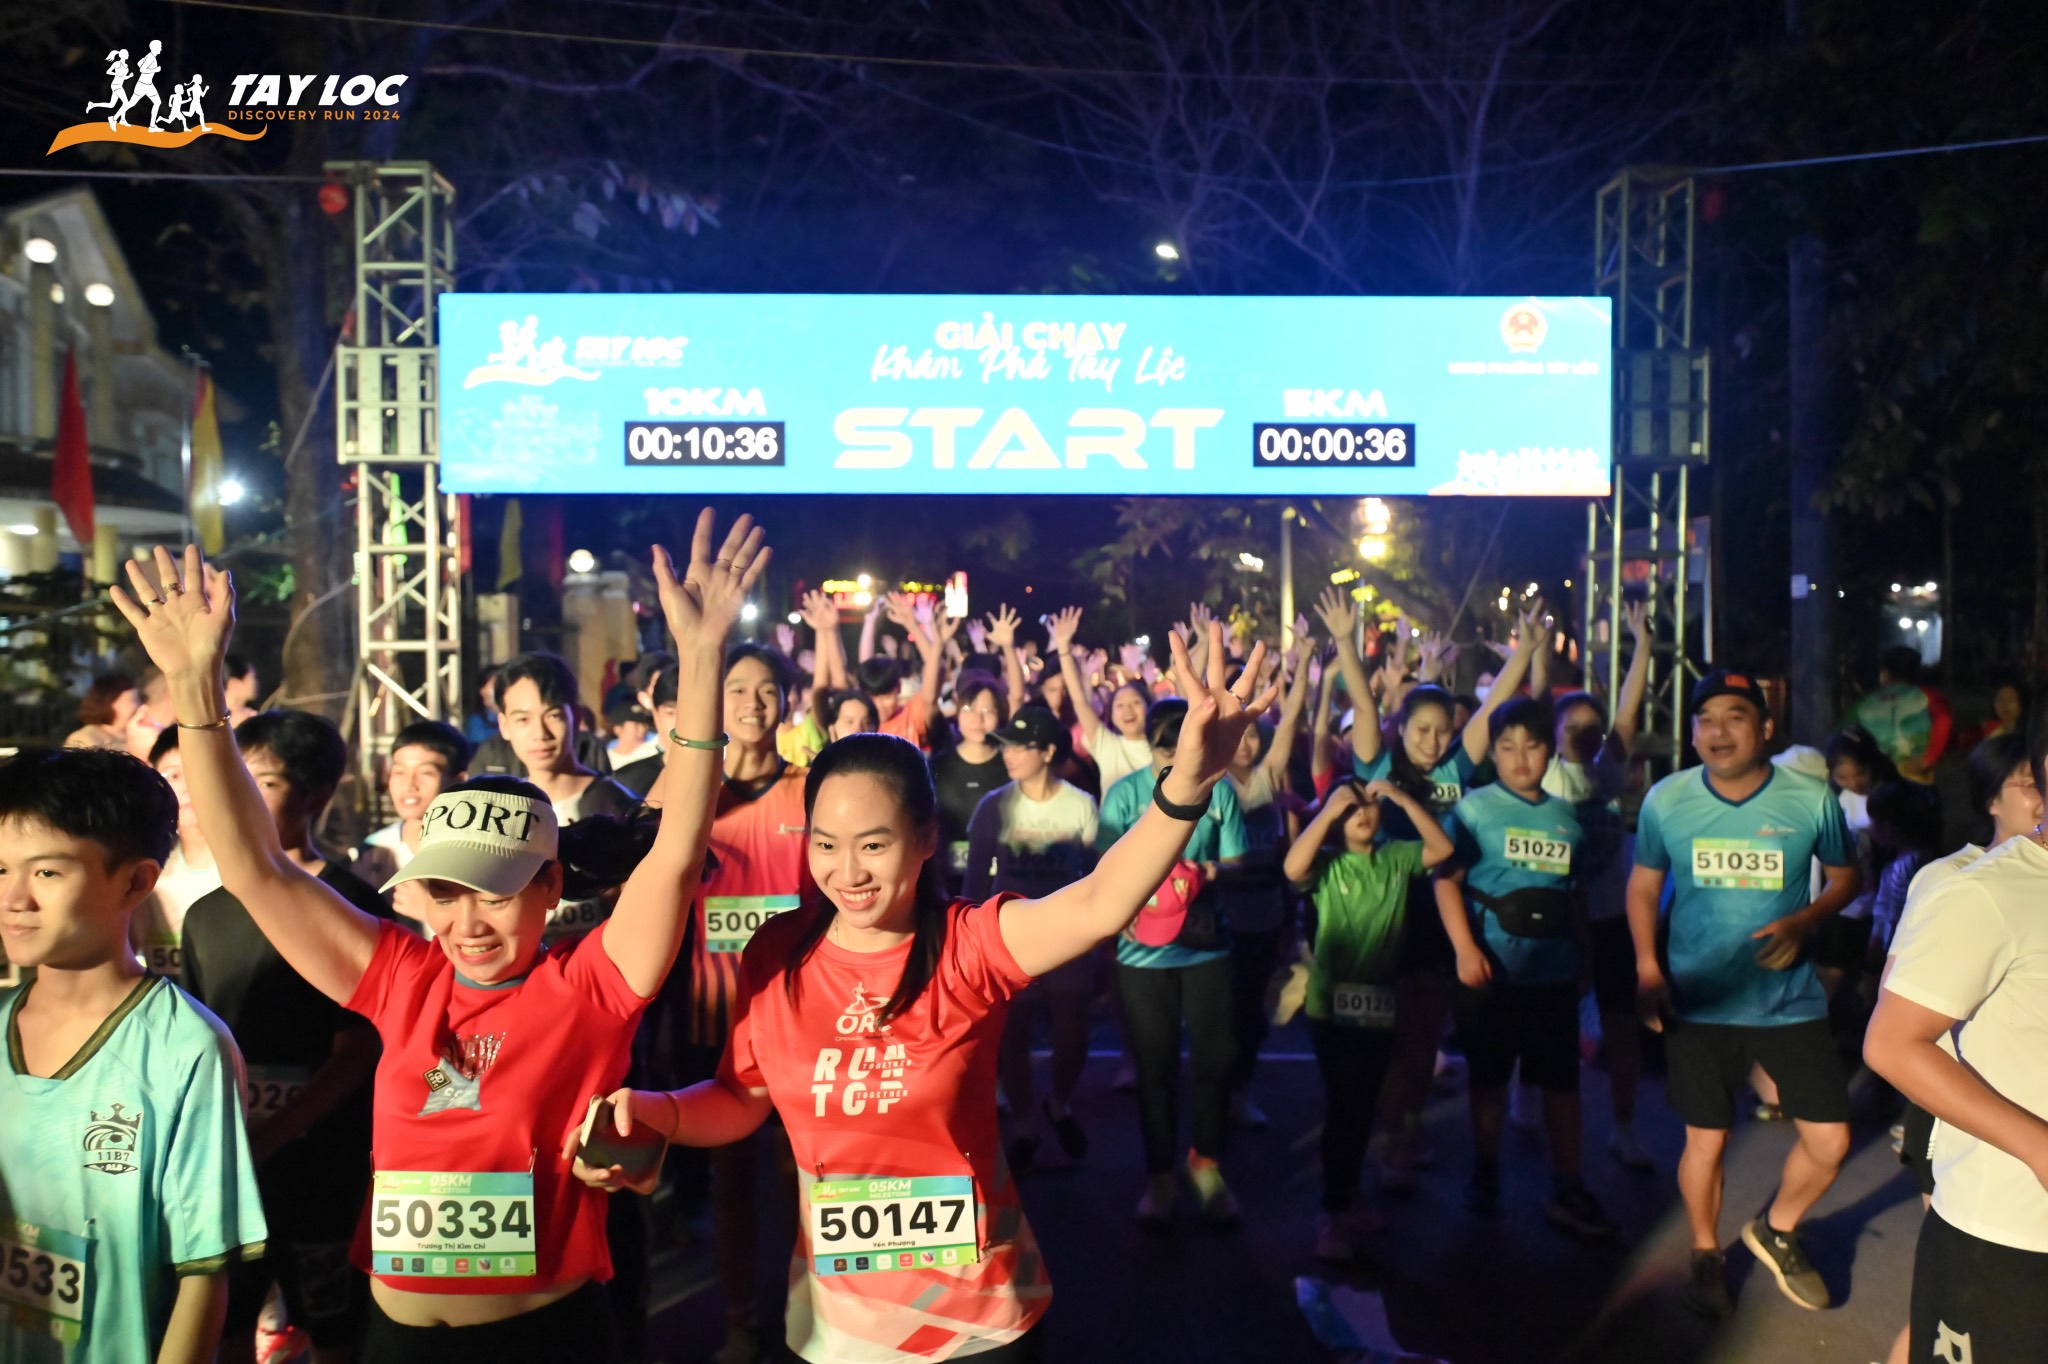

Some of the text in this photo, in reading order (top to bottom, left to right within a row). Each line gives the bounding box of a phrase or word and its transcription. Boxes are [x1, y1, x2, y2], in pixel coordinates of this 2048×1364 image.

[935, 311, 1014, 351] GIẢI
[871, 345, 964, 383] Khám
[979, 343, 1052, 384] Phá
[1134, 346, 1186, 387] Lộc
[643, 387, 767, 416] 10KM
[1283, 389, 1388, 417] 5KM
[629, 426, 778, 460] 00:10:36
[832, 407, 1226, 470] START
[1259, 427, 1407, 461] 00:00:36
[1508, 837, 1568, 860] 51027
[1696, 851, 1779, 872] 51035
[862, 1059, 912, 1070] TOGETHER
[856, 1089, 909, 1100] TOGETHER
[97, 1151, 130, 1162] 11B7
[429, 1174, 473, 1187] 05KM
[868, 1179, 912, 1193] 05KM
[869, 1190, 911, 1199] MILESTONE
[375, 1199, 532, 1240] 50334
[820, 1199, 966, 1242] 50147
[0, 1243, 81, 1305] 533
